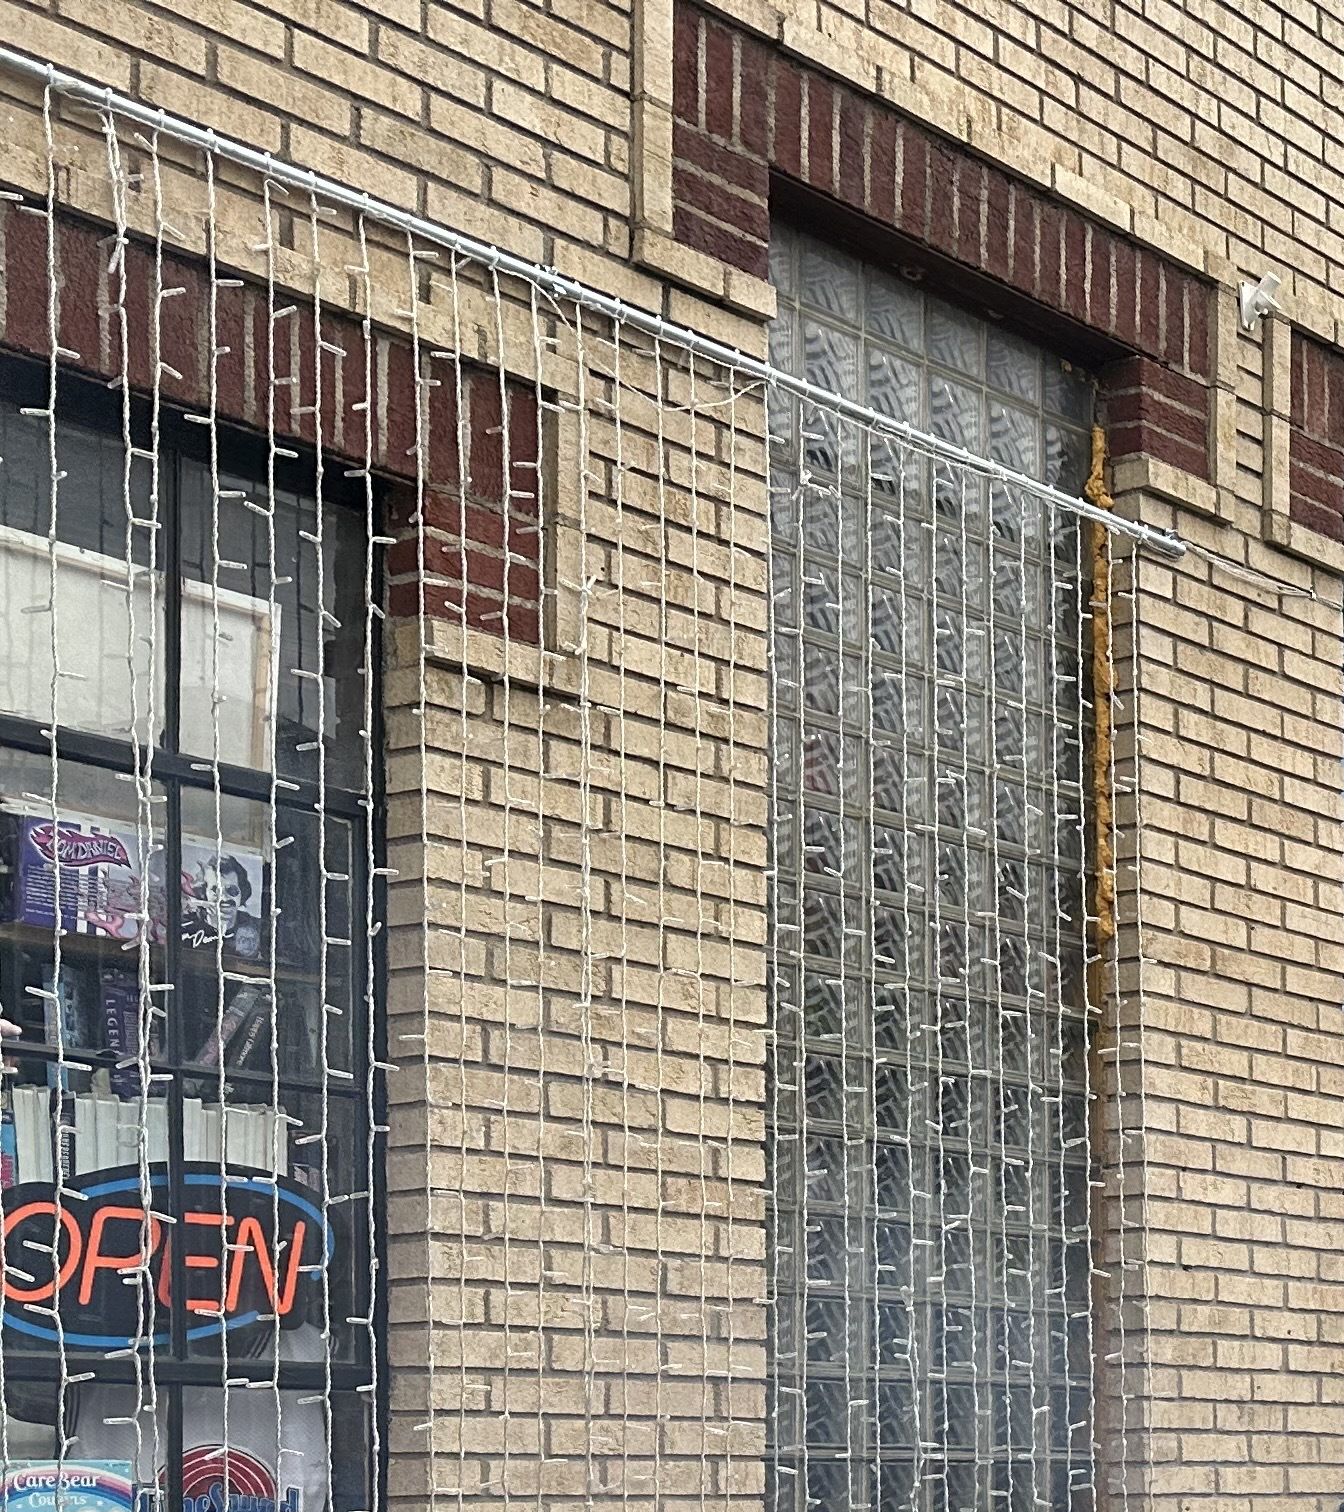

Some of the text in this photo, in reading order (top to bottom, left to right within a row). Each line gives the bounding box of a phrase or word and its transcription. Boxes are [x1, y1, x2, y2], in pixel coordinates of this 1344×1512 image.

[0, 1202, 306, 1316] OPEN
[13, 1471, 101, 1492] Care Bear
